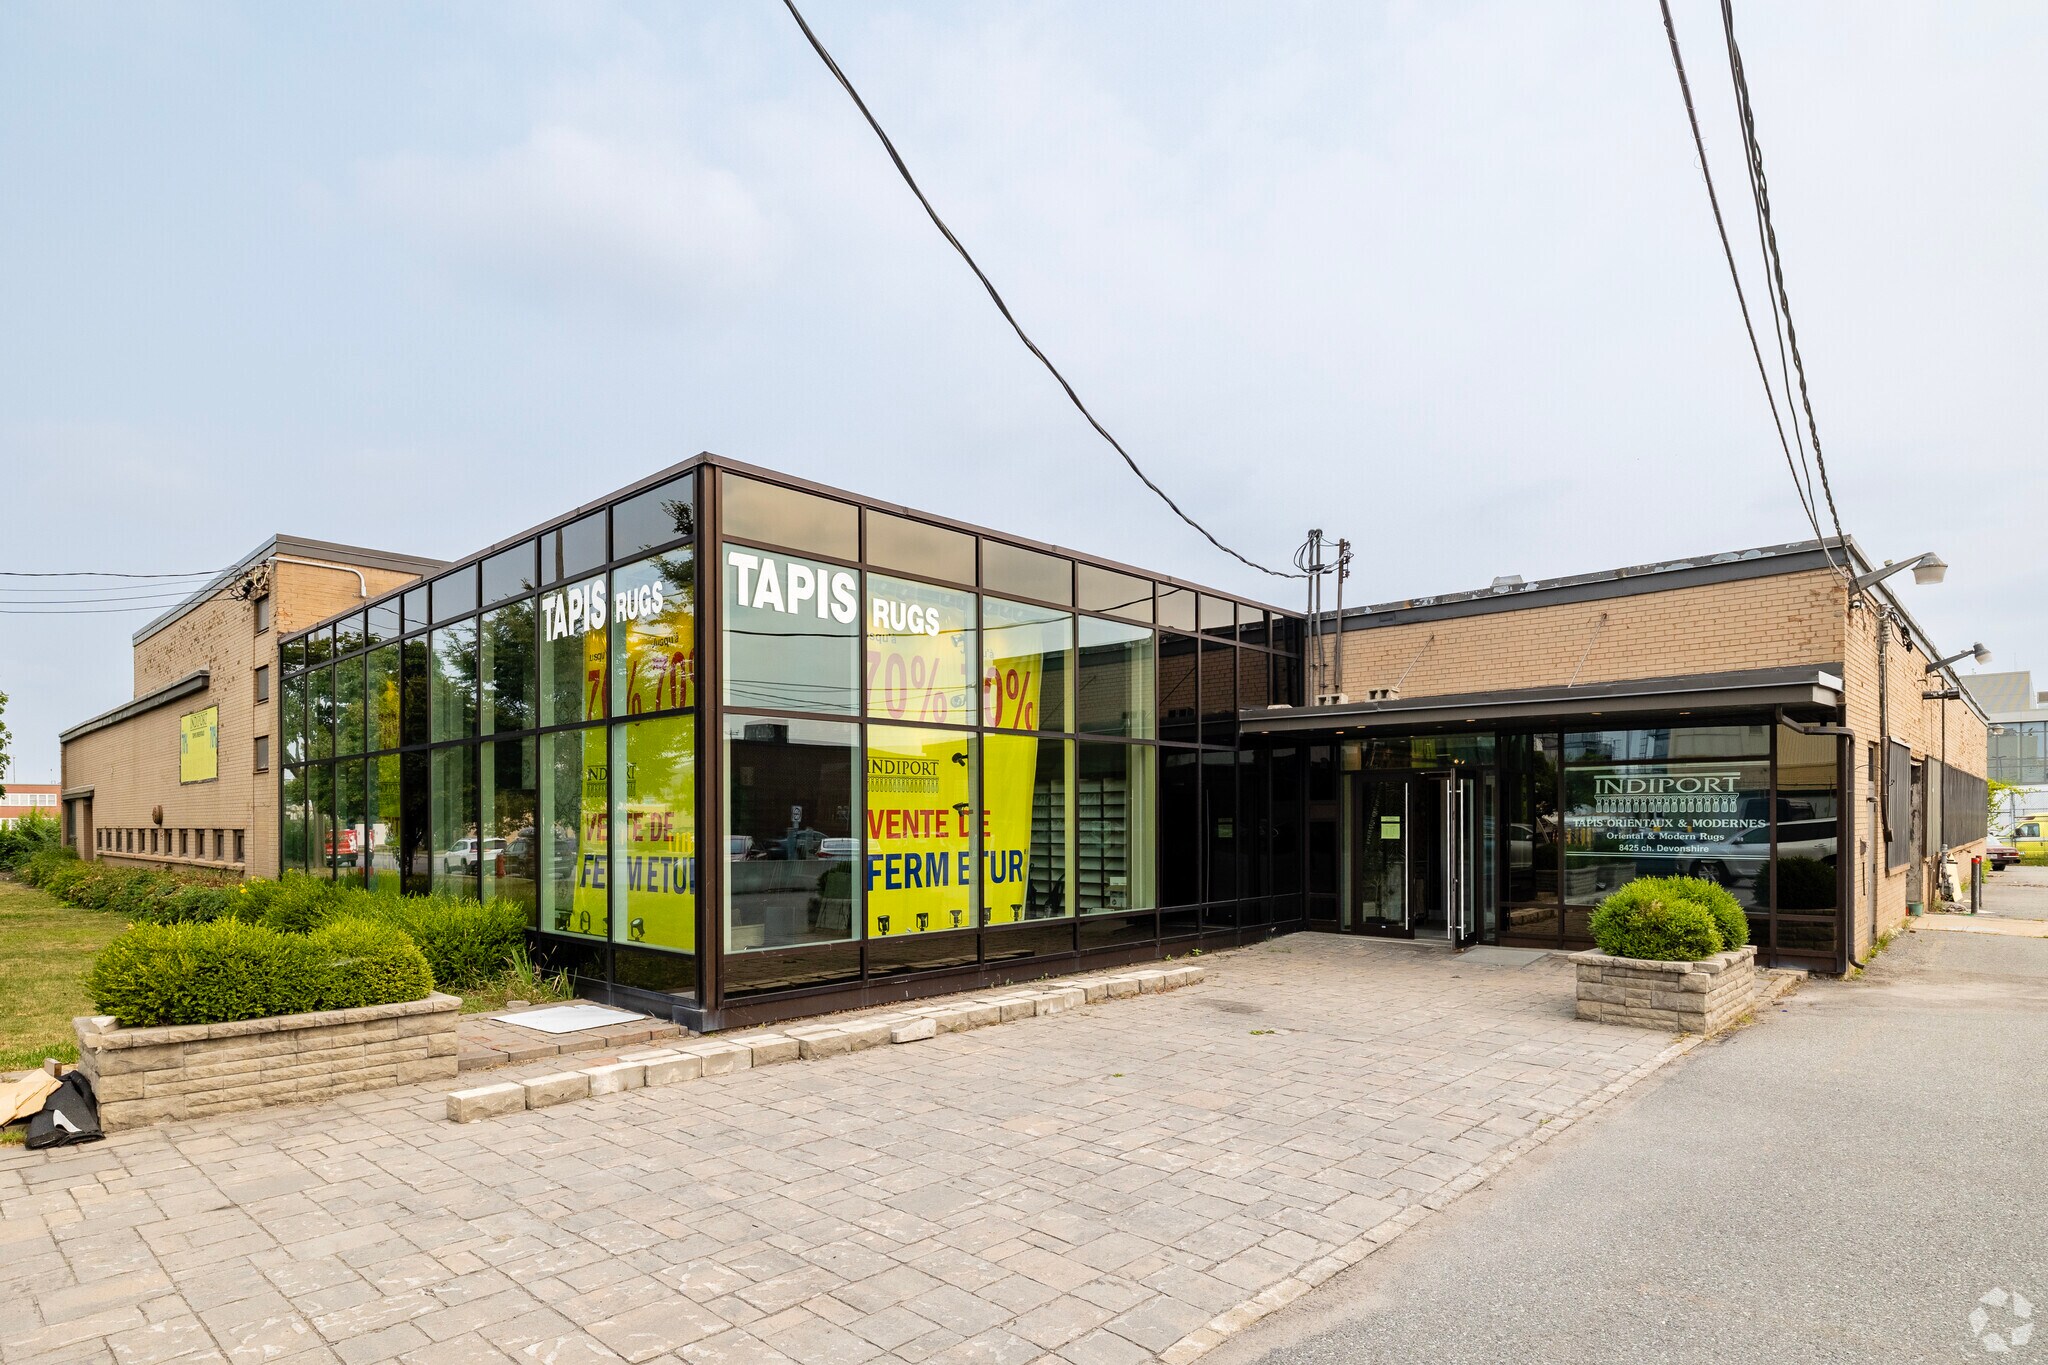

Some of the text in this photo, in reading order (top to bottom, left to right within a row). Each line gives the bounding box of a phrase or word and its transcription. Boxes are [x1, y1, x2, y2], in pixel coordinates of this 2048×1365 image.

[728, 551, 940, 637] TAPIS RUGS
[542, 579, 664, 642] TAPIS RUGS
[867, 633, 897, 644] squ'à
[1595, 777, 1741, 794] INDIPORT
[650, 812, 674, 842] DE
[867, 809, 950, 840] VENTE
[1573, 819, 1766, 828] TAPIS ORIENTAUX & MODERNES
[1606, 832, 1725, 842] Oriental & Modern Rugs
[1618, 844, 1710, 853] 8425 ch. Devonshire
